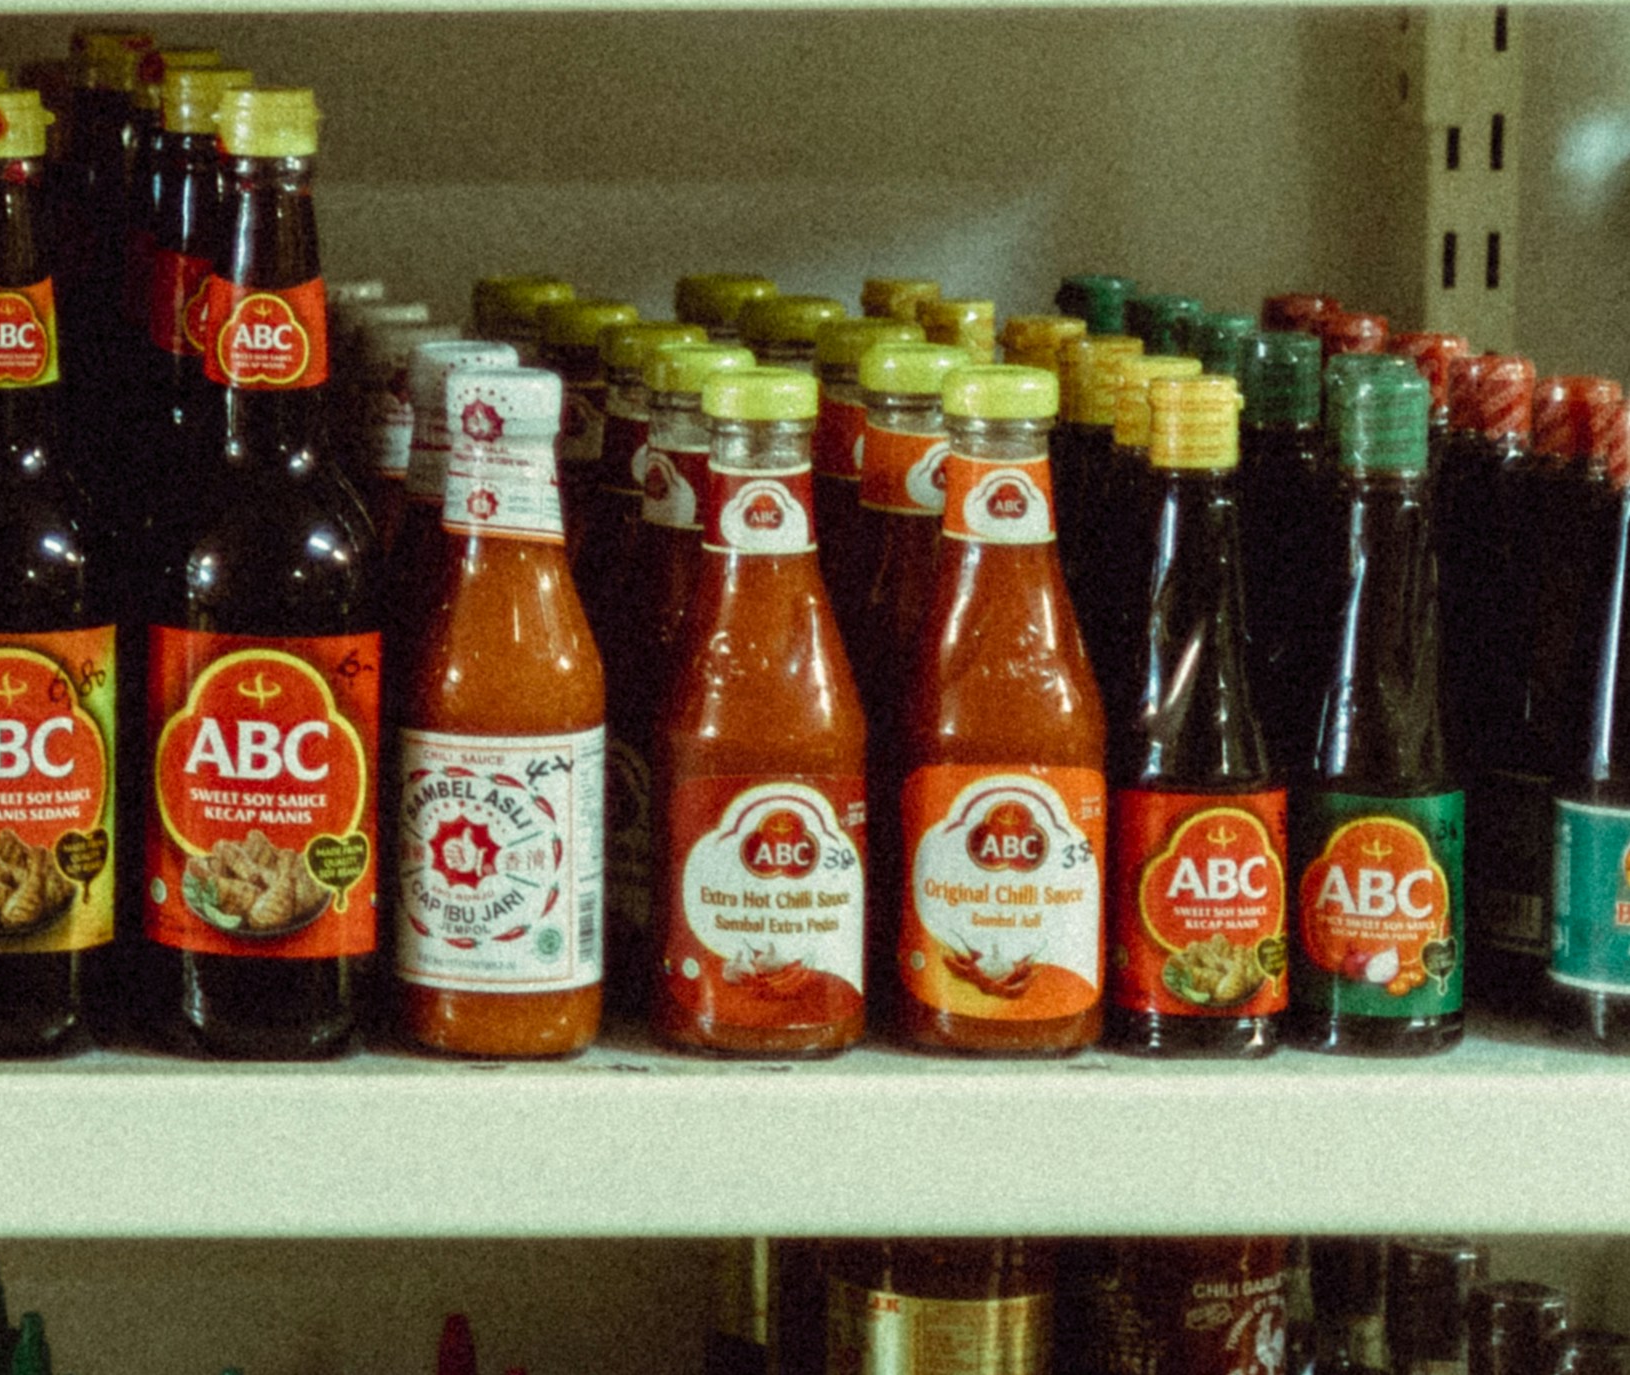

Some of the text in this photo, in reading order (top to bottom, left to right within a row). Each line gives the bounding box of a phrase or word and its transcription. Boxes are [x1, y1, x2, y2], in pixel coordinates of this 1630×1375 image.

[232, 324, 294, 351] ABC
[750, 510, 779, 524] ABC
[994, 500, 1026, 514] ABC
[182, 716, 331, 784] ABC
[459, 752, 506, 766] SAUCE
[24, 788, 54, 805] SOY
[54, 786, 92, 804] SAUCE
[189, 786, 328, 809] SWEET SOY SAUCE
[405, 779, 534, 832] SAMBEL ASLI
[27, 804, 82, 821] SEDANG
[203, 806, 314, 825] KECAP MANIS
[752, 839, 812, 867] ABC
[979, 835, 1040, 860] ABC
[1165, 855, 1268, 901] ABC
[410, 878, 526, 924] CAP IBU JARI
[700, 885, 739, 909] Extra
[742, 888, 772, 910] Hot
[775, 889, 813, 910] Chilli
[923, 878, 1085, 907] Original Chilli Sauce
[1314, 866, 1435, 920] ABC
